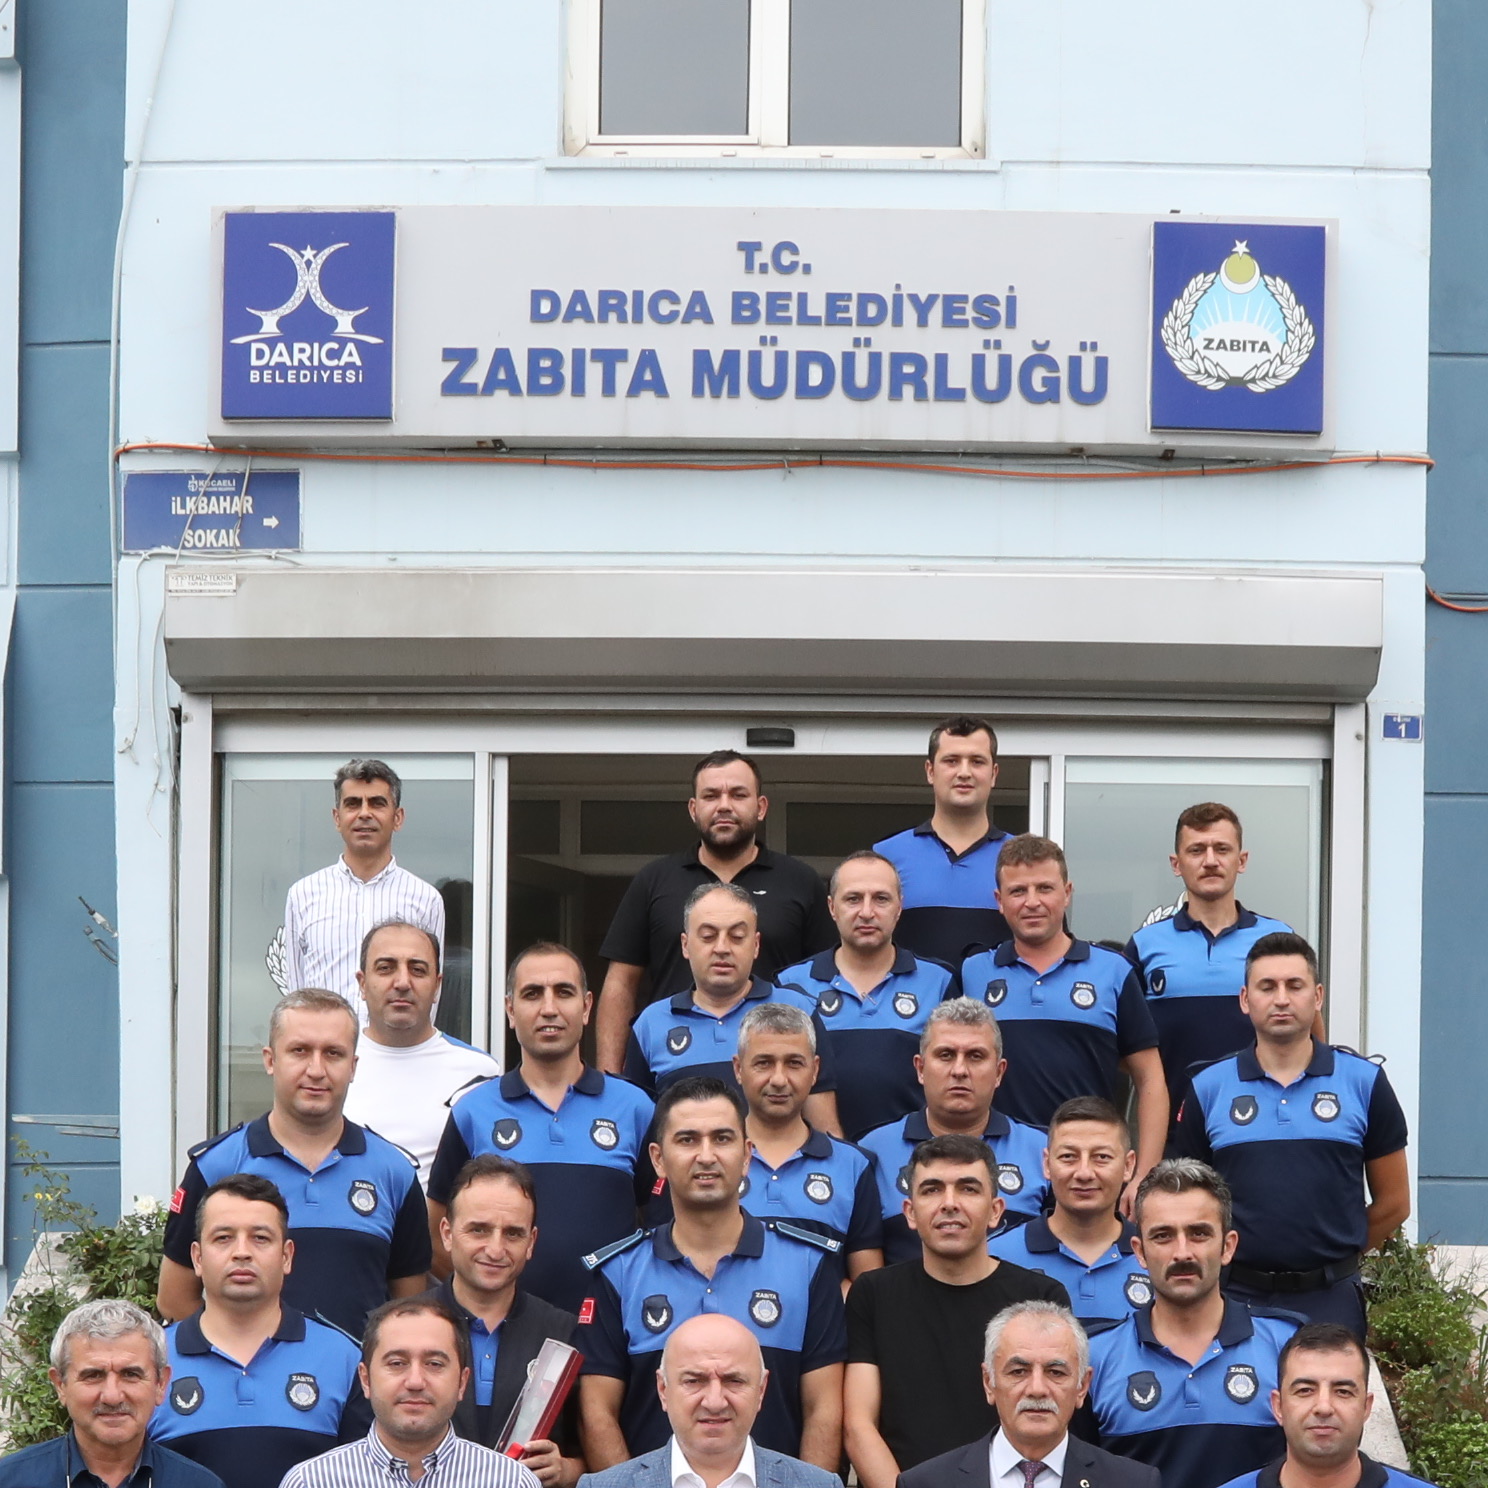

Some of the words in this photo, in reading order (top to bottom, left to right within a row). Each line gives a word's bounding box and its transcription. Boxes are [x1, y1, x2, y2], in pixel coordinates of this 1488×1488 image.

[737, 241, 812, 275] T.C.
[529, 288, 714, 325] DARICA
[731, 283, 1017, 329] BELEDİYESİ
[250, 341, 362, 367] DARICA
[1202, 337, 1272, 354] ZABITA
[250, 369, 363, 383] BELEDİYESİ
[440, 346, 669, 398] ZABITA
[692, 336, 1109, 406] MÜDÜRLÜĞÜ
[184, 529, 241, 548] SOKAK
[1398, 722, 1406, 738] 1
[755, 1291, 777, 1300] ZABITA
[1230, 1366, 1253, 1374] ZABITA
[292, 1375, 314, 1383] ZABITA
